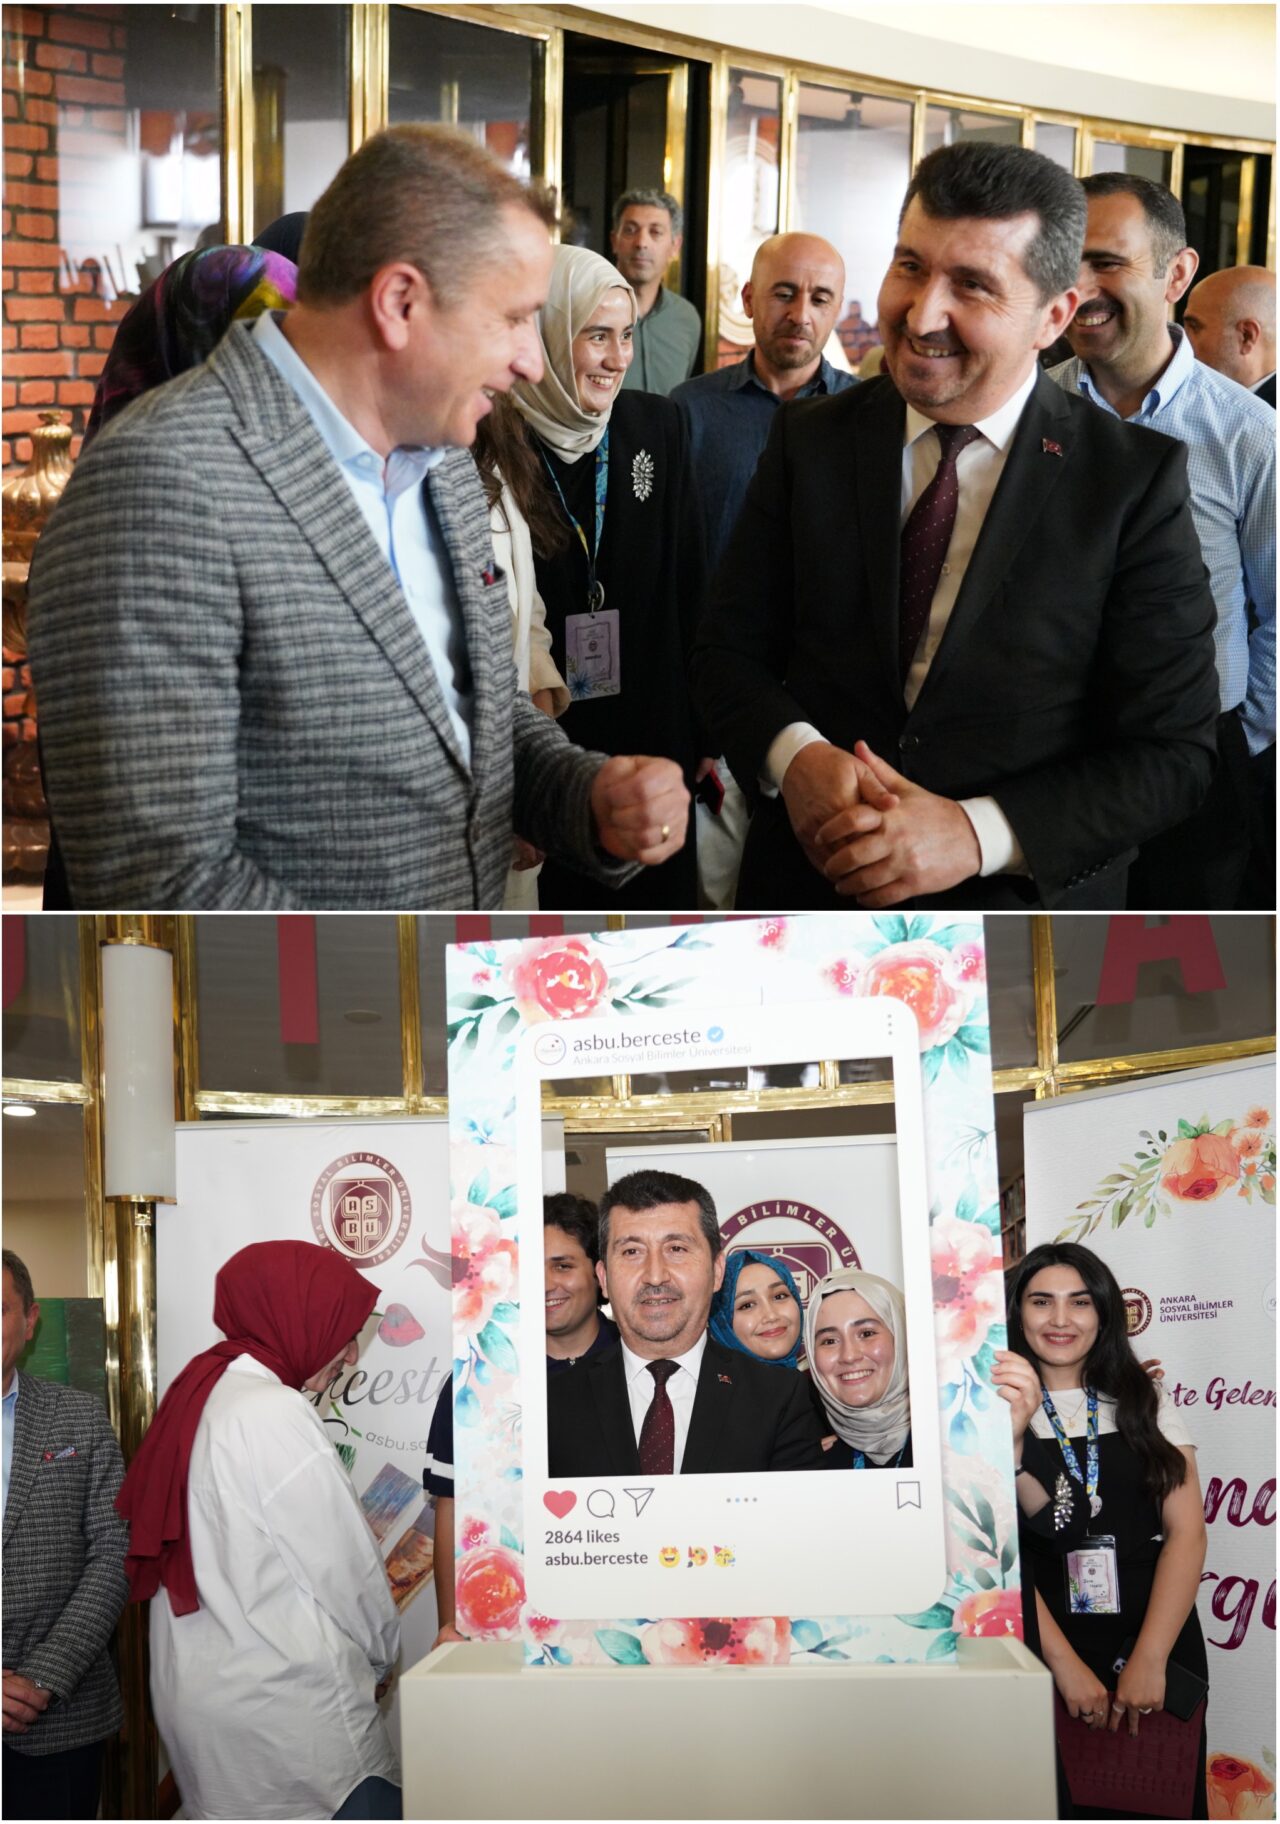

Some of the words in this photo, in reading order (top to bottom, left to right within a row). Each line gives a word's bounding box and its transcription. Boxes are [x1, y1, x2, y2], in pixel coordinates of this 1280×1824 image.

[573, 1028, 701, 1051] asbu.berceste
[573, 1055, 610, 1066] Ankara
[612, 1053, 644, 1066] Sosyal
[647, 1048, 686, 1061] Bilimler
[737, 1202, 837, 1239] BİLİMLER
[1160, 1295, 1196, 1304] ANKARA
[1160, 1304, 1191, 1314] SOSYAL
[1194, 1300, 1234, 1311] BİLİMLER
[1160, 1311, 1218, 1322] ÜNİVERSİTESİ
[545, 1531, 583, 1544] 2864
[586, 1529, 620, 1543] likes
[545, 1551, 648, 1566] asbu.berceste
